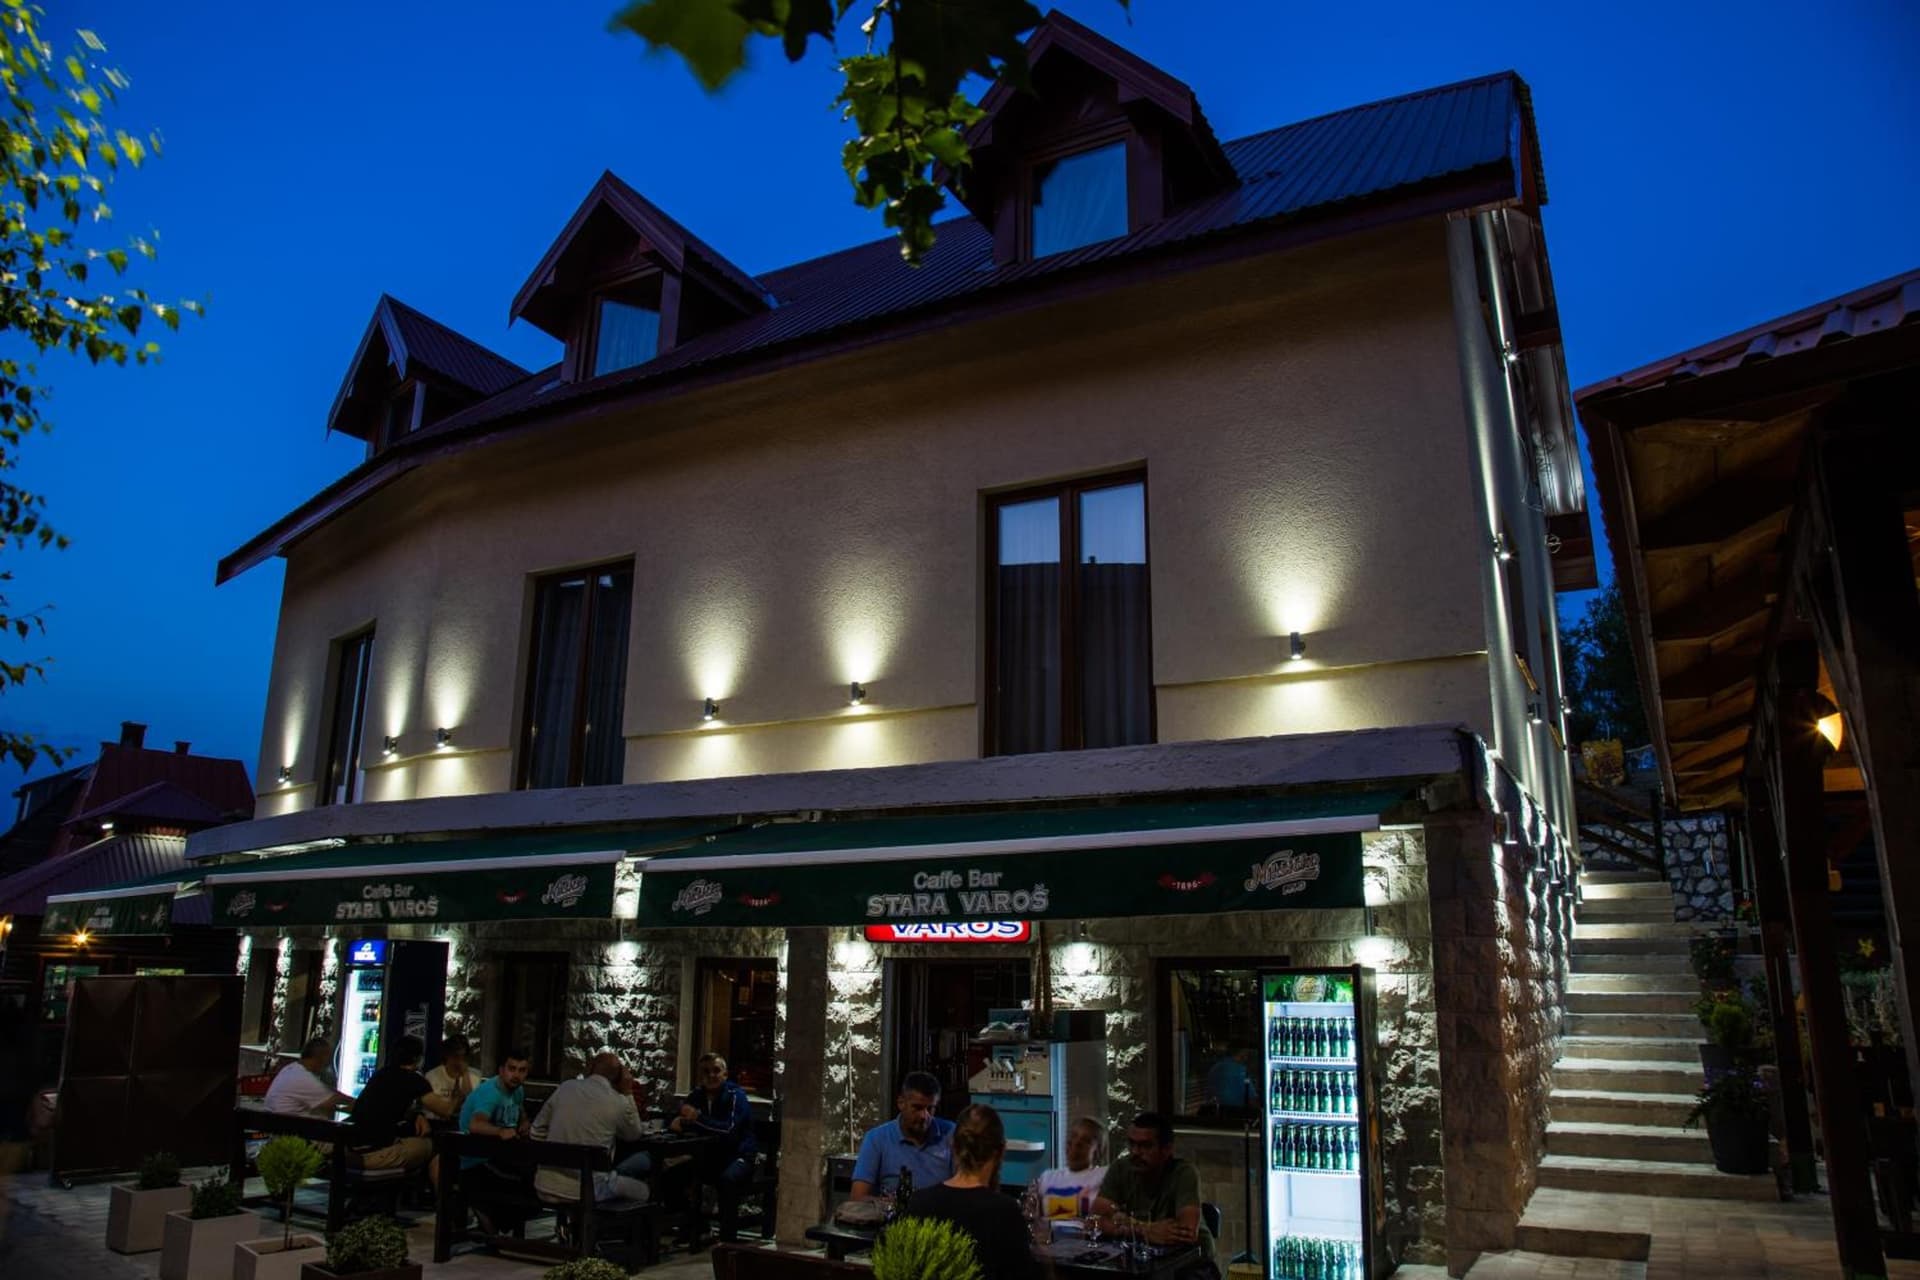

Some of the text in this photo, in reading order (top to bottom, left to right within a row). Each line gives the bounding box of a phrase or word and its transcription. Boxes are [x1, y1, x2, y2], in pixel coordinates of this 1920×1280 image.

[913, 869, 1003, 889] Caffe Bar
[335, 895, 440, 919] STARA VAROŠ
[865, 882, 1050, 917] STARA VAROŠ
